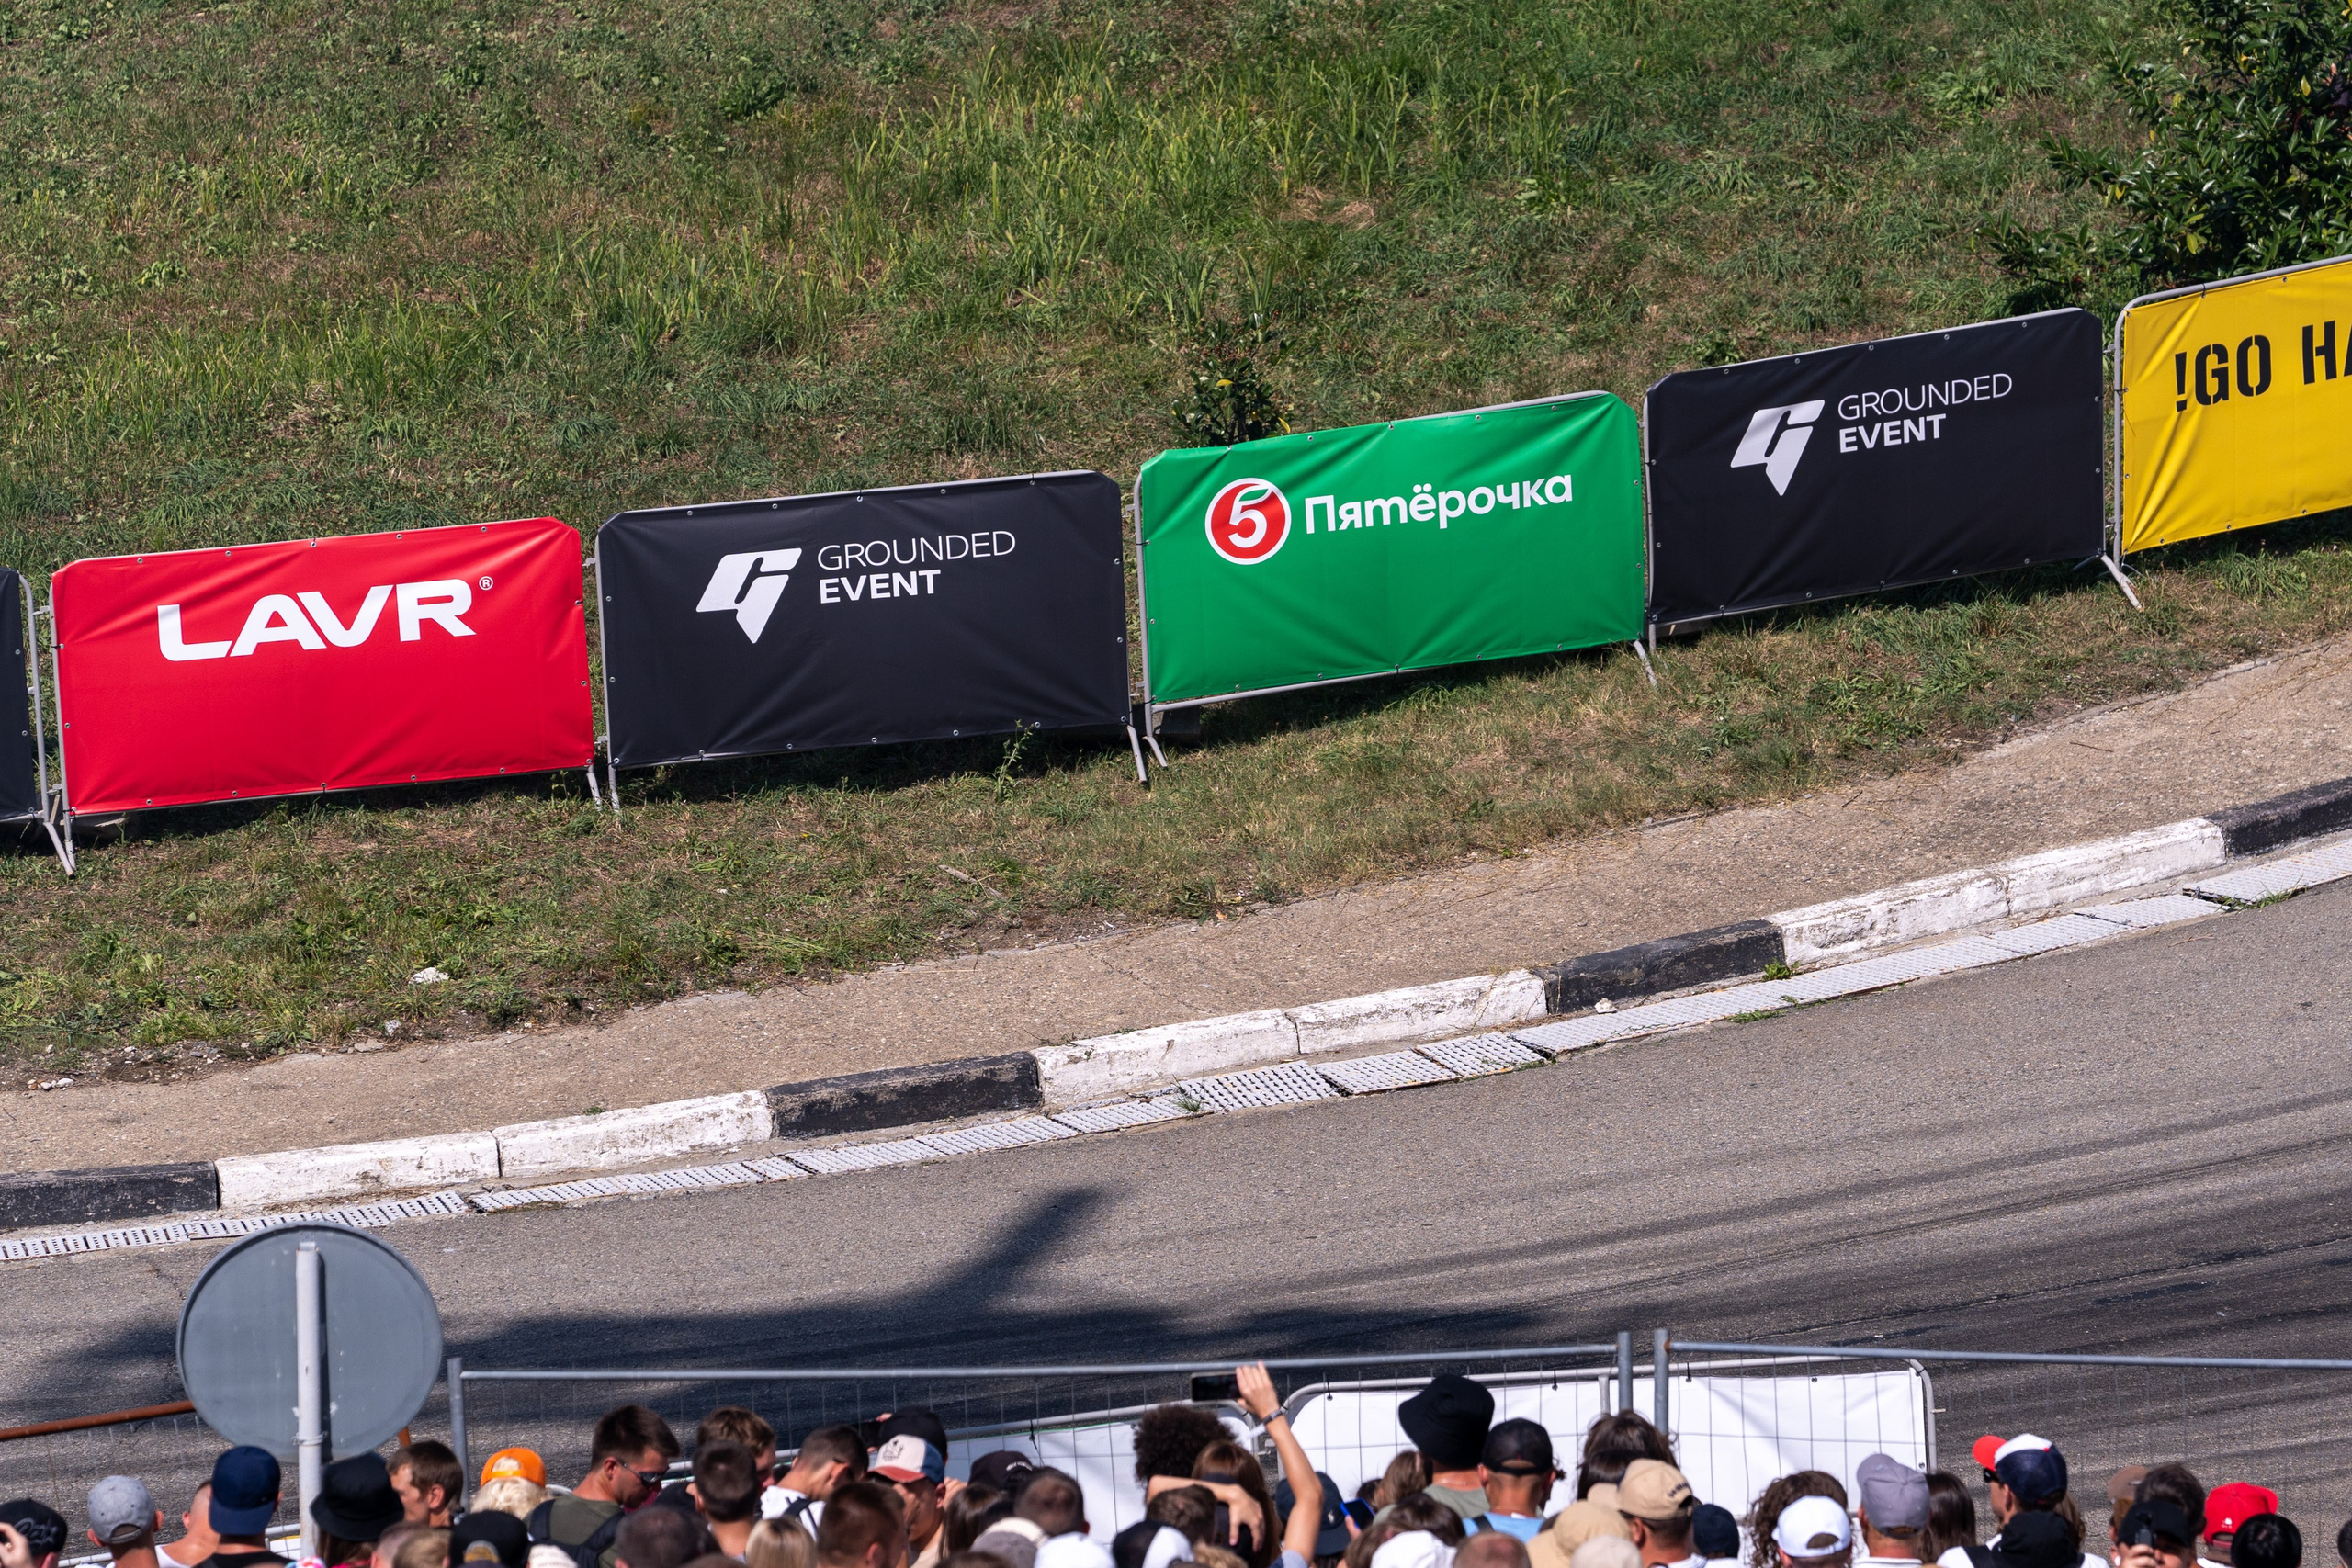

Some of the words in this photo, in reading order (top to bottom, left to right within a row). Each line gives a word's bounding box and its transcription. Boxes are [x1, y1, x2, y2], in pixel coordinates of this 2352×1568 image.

[2301, 320, 2352, 385] H
[1837, 372, 2014, 421] GROUNDED
[1839, 413, 1947, 454] EVENT
[1305, 474, 1573, 530] Пятёрочка
[817, 530, 1016, 570] GROUNDED
[819, 570, 942, 604] EVENT
